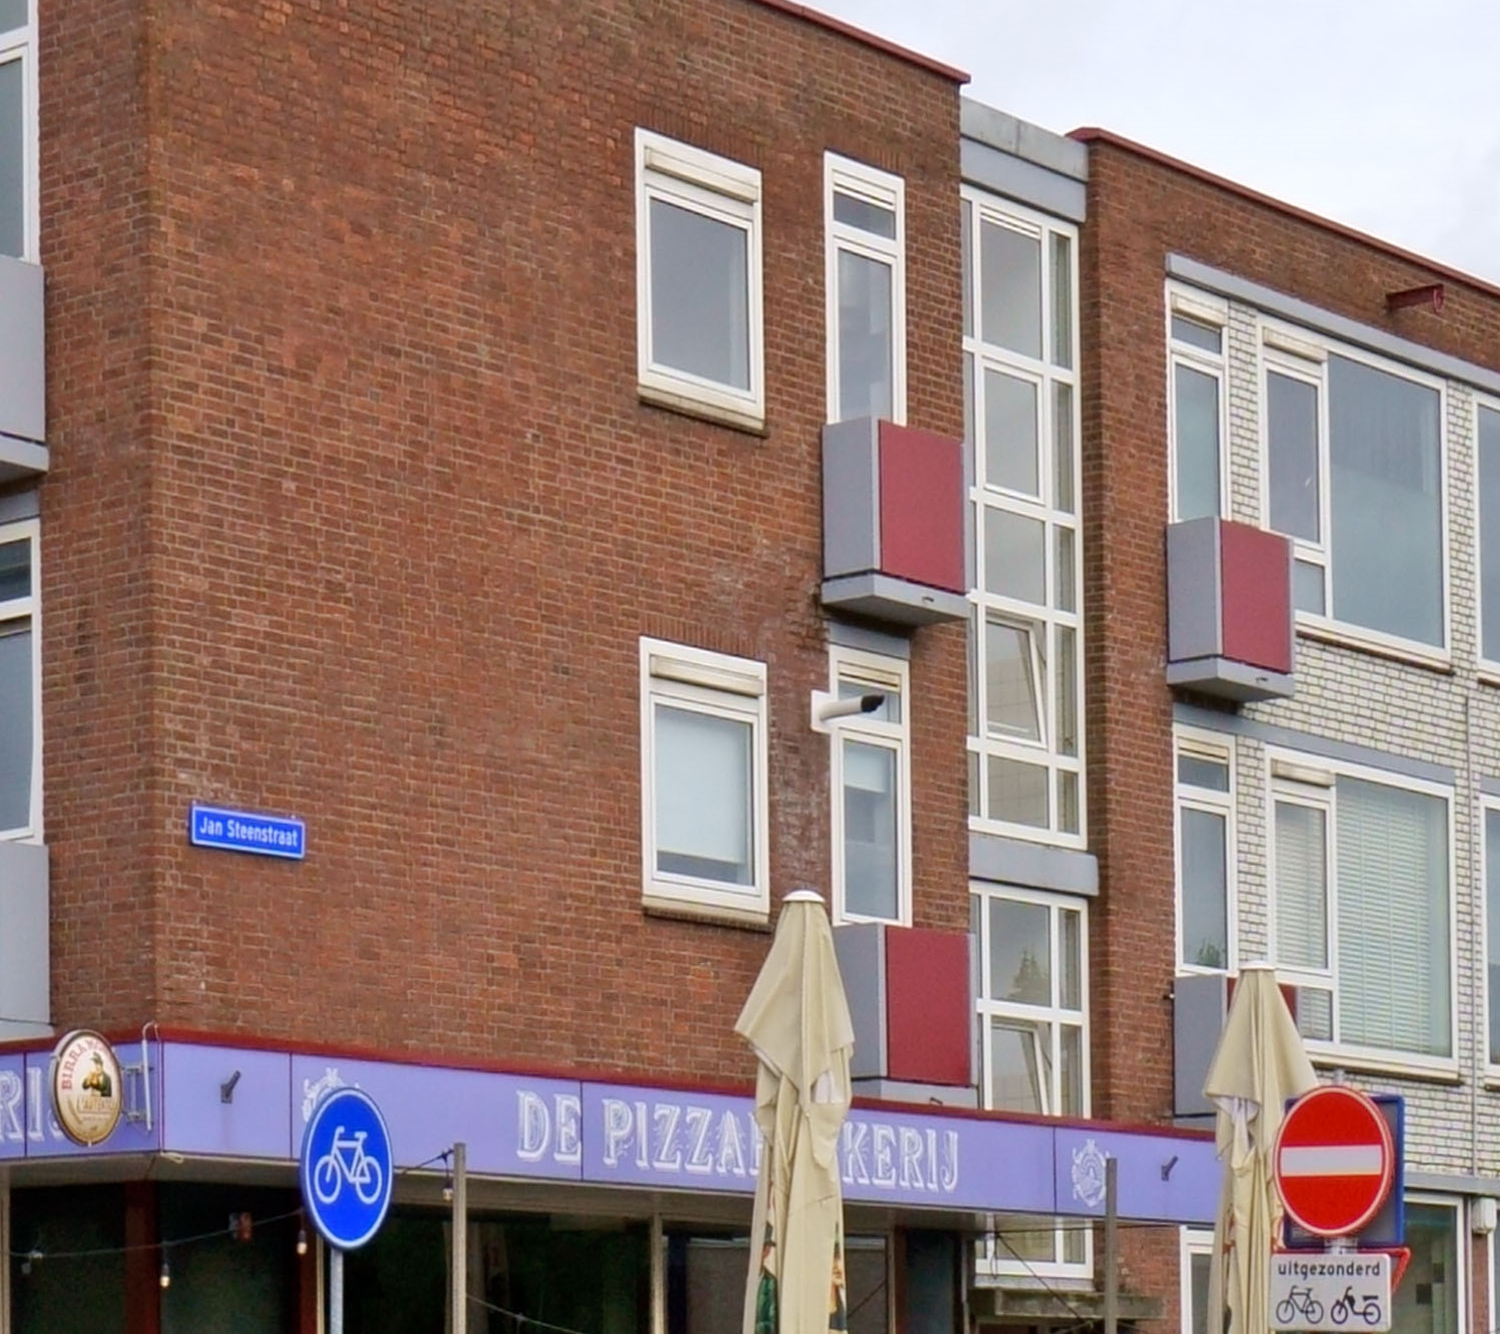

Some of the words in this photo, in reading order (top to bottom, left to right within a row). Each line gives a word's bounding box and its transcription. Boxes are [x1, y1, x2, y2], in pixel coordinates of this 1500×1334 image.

[200, 816, 223, 836] Jan
[227, 819, 298, 847] Steenstraat
[515, 1090, 582, 1163] DE
[602, 1097, 959, 1194] PIZZAKERIJ
[1278, 1261, 1381, 1280] uitgezonderd
